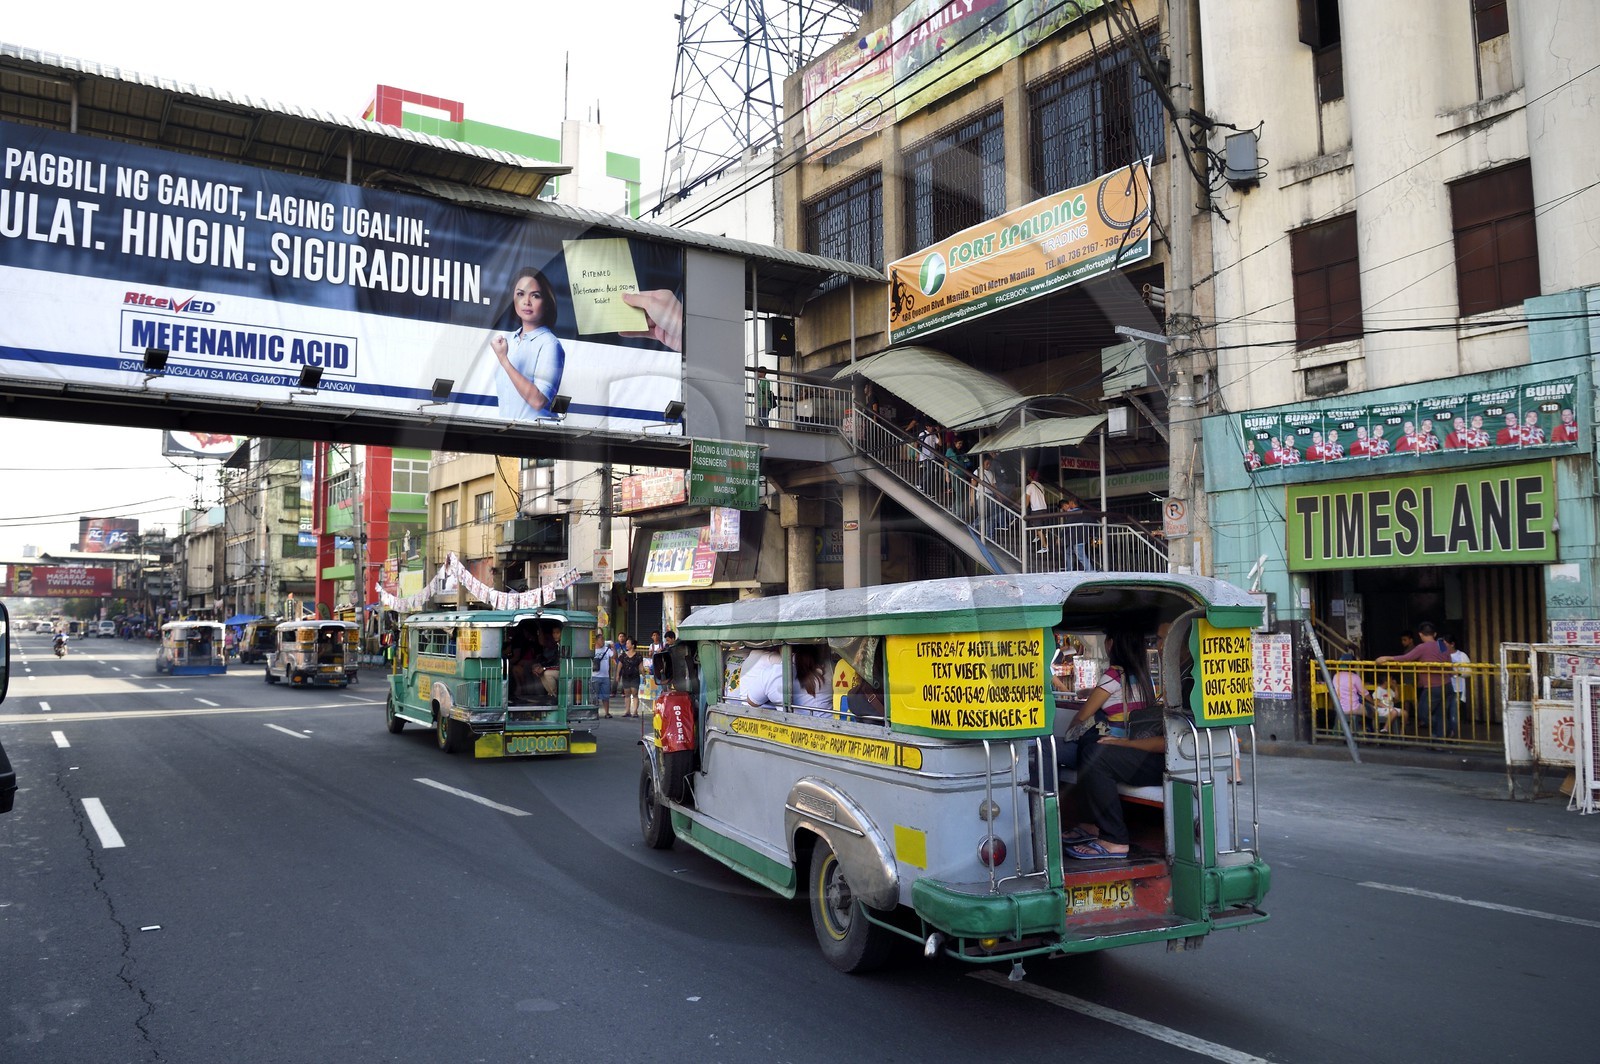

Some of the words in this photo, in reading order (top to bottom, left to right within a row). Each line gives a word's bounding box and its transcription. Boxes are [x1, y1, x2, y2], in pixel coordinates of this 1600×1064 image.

[909, 0, 975, 45] FAMILY
[5, 147, 107, 194] PAGBILI
[116, 167, 149, 201] NG
[157, 174, 247, 222] GAMOT,
[256, 191, 335, 232] LAGING
[342, 208, 431, 248] UGALIIN:
[949, 233, 996, 267] FORT
[999, 194, 1087, 249] SPALDING
[1040, 225, 1088, 255] TRADING
[121, 208, 256, 271] HINGIN.
[270, 233, 491, 305] SIGURADUHIN.
[1045, 259, 1057, 271] TEL.
[1057, 255, 1068, 266] NO.
[1068, 248, 1081, 261] 736
[1082, 242, 1099, 257] 2167
[995, 288, 1029, 304] FACEBOOK:
[1030, 245, 1143, 292] www.facebook.com/fortspaldigbikes
[912, 306, 930, 320] Quezon
[988, 276, 1008, 291] Metro
[1009, 267, 1036, 282] Manila
[132, 319, 284, 362] MEFENAMIC
[290, 338, 349, 369] ACID
[119, 361, 151, 372] ISAN
[210, 370, 223, 379] SA
[226, 372, 248, 381] MGA
[251, 374, 287, 385] GAMOT
[1526, 383, 1574, 397] BUHAY
[1245, 416, 1278, 428] BUHAY
[1340, 422, 1354, 430] 110
[1296, 475, 1547, 561] TIMESLANE
[917, 642, 942, 658] LTFRB
[944, 641, 964, 657] 24/7
[1203, 637, 1232, 654] LTFRB
[932, 662, 952, 679] TEXT
[955, 663, 987, 680] VIBER
[991, 663, 1039, 679] HOTLINE:
[1204, 659, 1226, 674] TEXT
[1228, 658, 1250, 673] VIBER
[1262, 644, 1272, 691] BELGICA
[1282, 644, 1292, 691] BELGICA
[673, 705, 684, 740] MOLDEX
[931, 710, 953, 727] MAX.
[1208, 700, 1235, 716] MAX.
[507, 735, 568, 753] JUDOKA
[862, 743, 890, 760] DAPITAN
